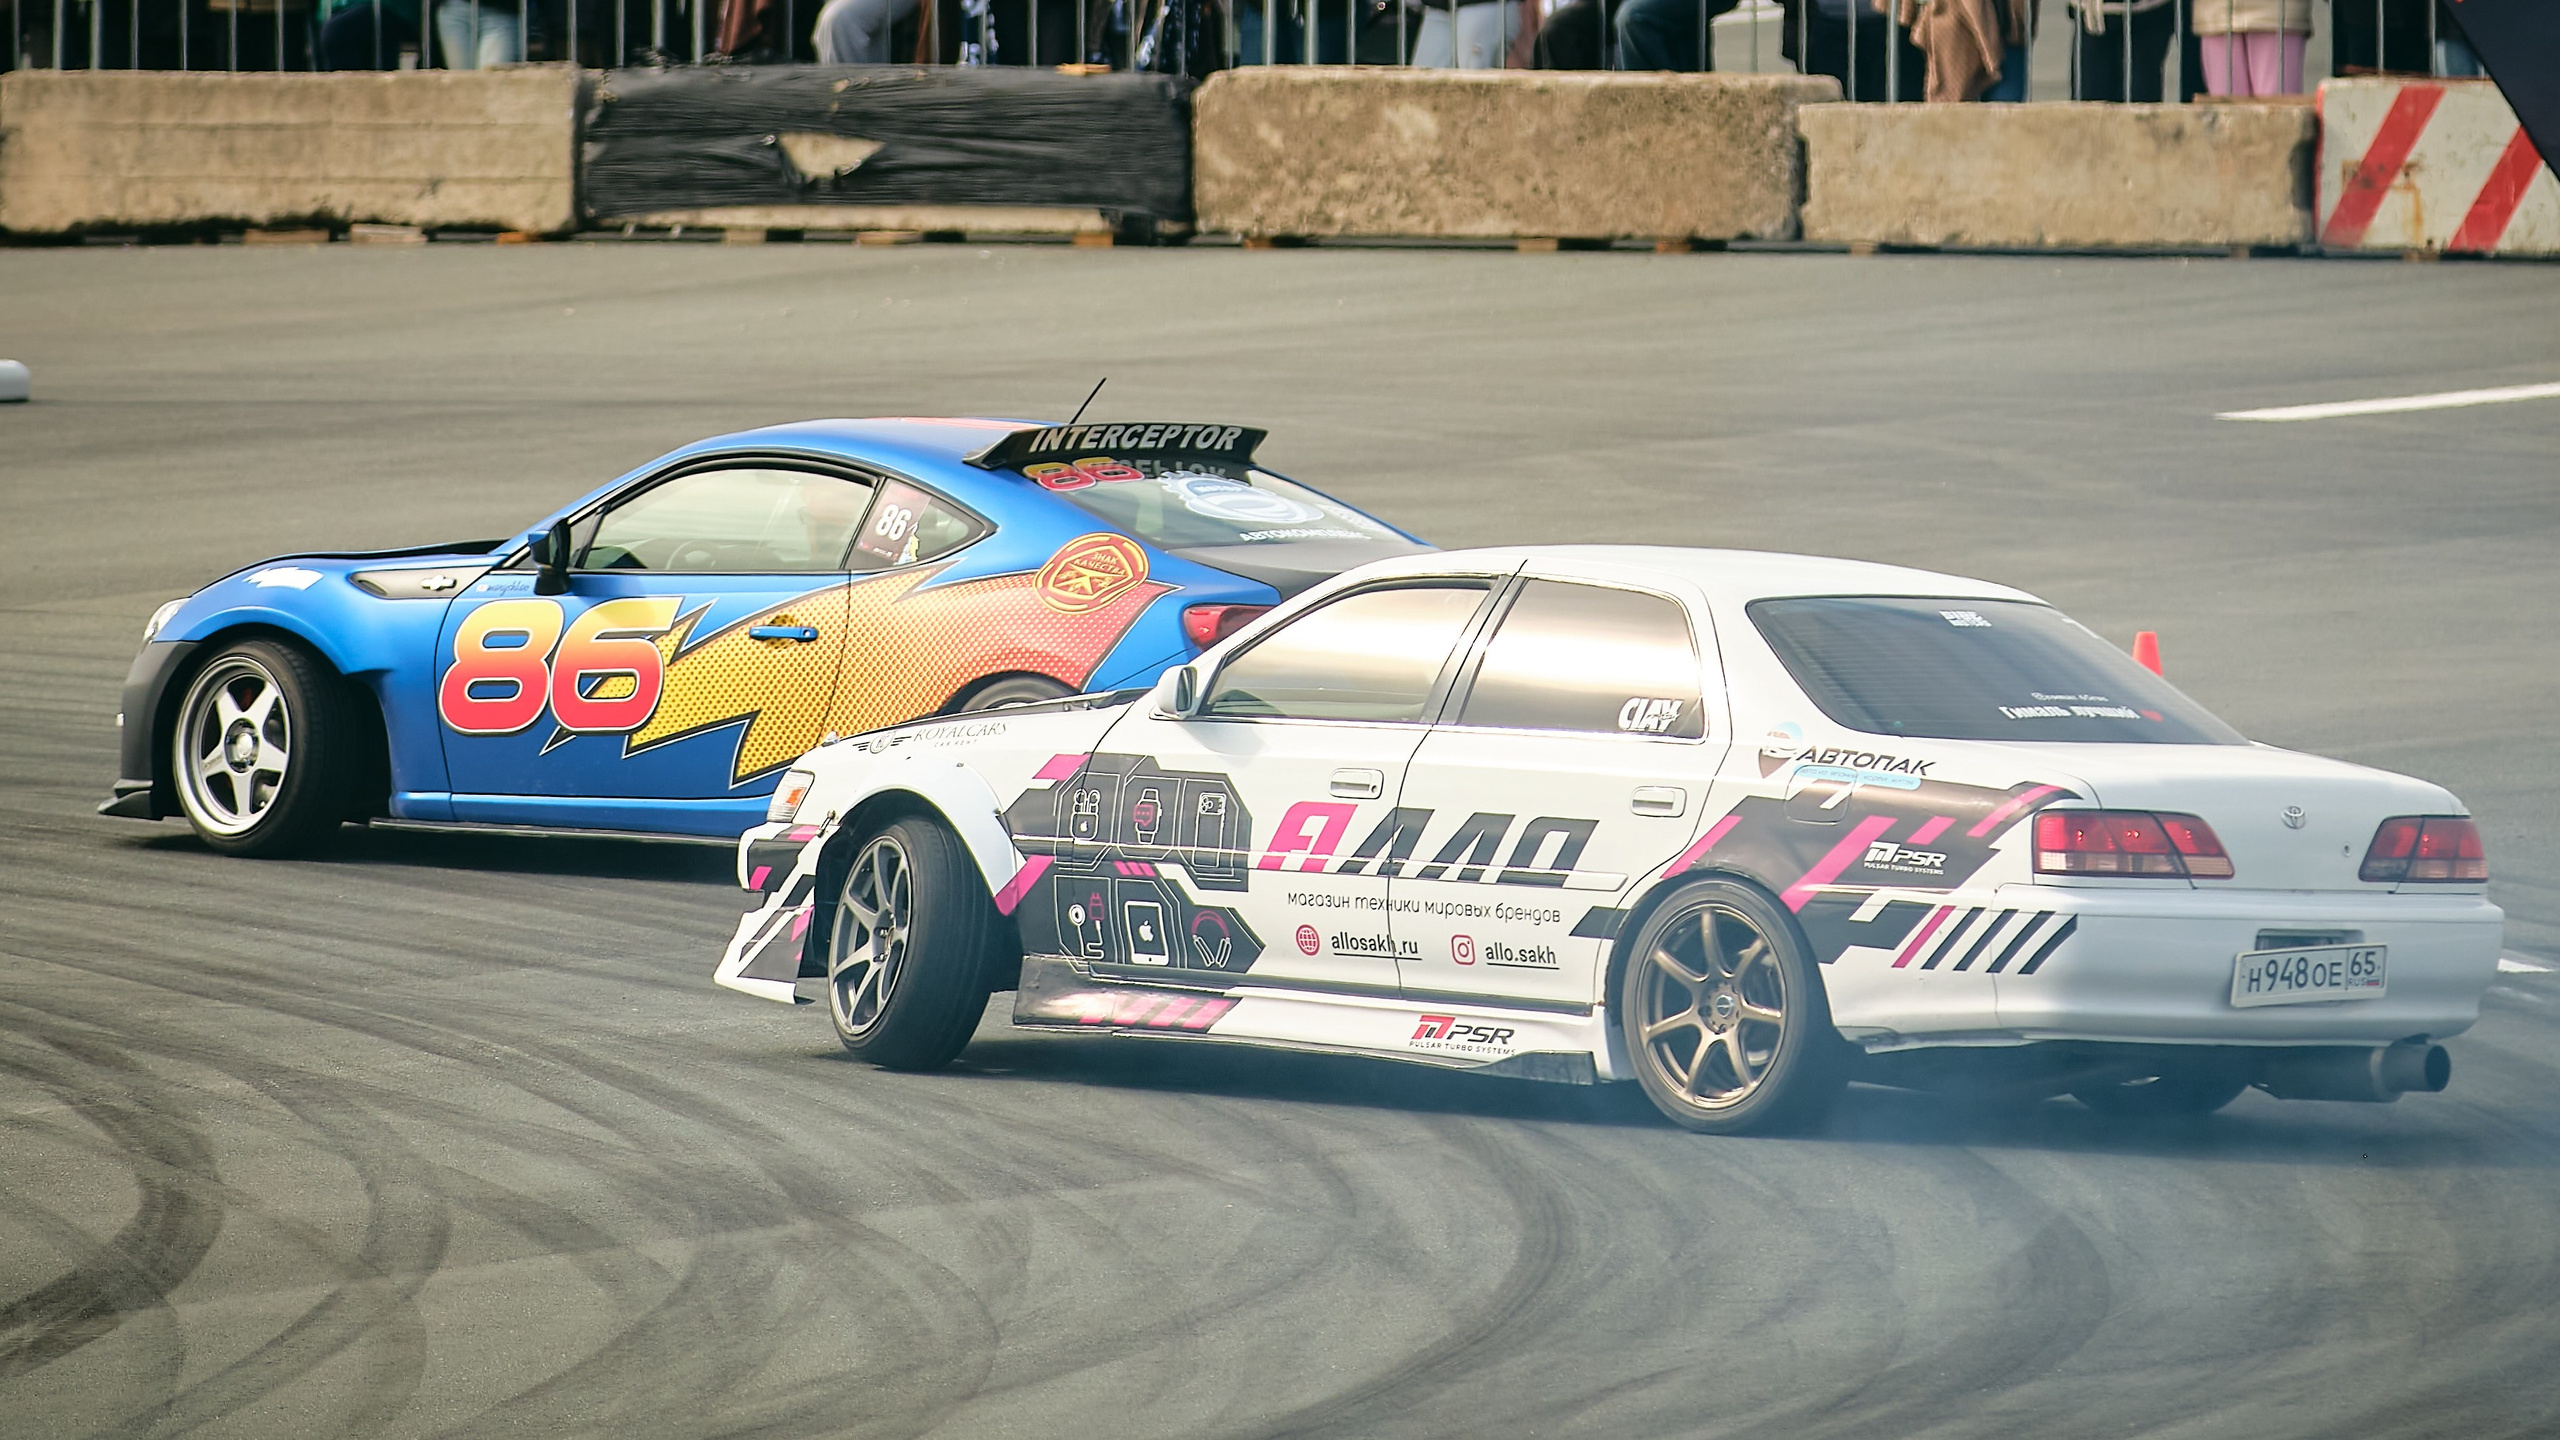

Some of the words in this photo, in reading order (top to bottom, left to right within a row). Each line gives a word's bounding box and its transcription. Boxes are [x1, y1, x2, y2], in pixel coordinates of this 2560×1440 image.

[1029, 424, 1242, 453] INTERCEPTOR
[1022, 456, 1145, 491] 86
[876, 503, 912, 541] 86
[1073, 558, 1127, 576] КАЧЕСТВА
[1092, 552, 1119, 565] ЗНАК
[439, 596, 684, 736] 86
[1796, 745, 1937, 776] АВТОПАК
[1258, 801, 1600, 888] АЛЛО
[1864, 862, 1890, 870] PULSAR
[1891, 864, 1914, 872] TURBO
[1914, 866, 1944, 875] SYSTEMS
[1891, 849, 1947, 867] PSR
[1288, 892, 1350, 909] магазин
[1355, 896, 1420, 913] техники
[1425, 901, 1491, 919] мировых
[1495, 902, 1561, 926] брендов
[1331, 931, 1419, 956] allosakh.ru
[1485, 942, 1557, 965] allo.sakh
[2350, 951, 2377, 977] 65
[2348, 977, 2367, 987] RUS
[1447, 1024, 1515, 1045] PSR
[1409, 1040, 1442, 1049] PULSAR
[1445, 1043, 1473, 1052] TURBO
[1476, 1045, 1516, 1057] SYSTEMS
